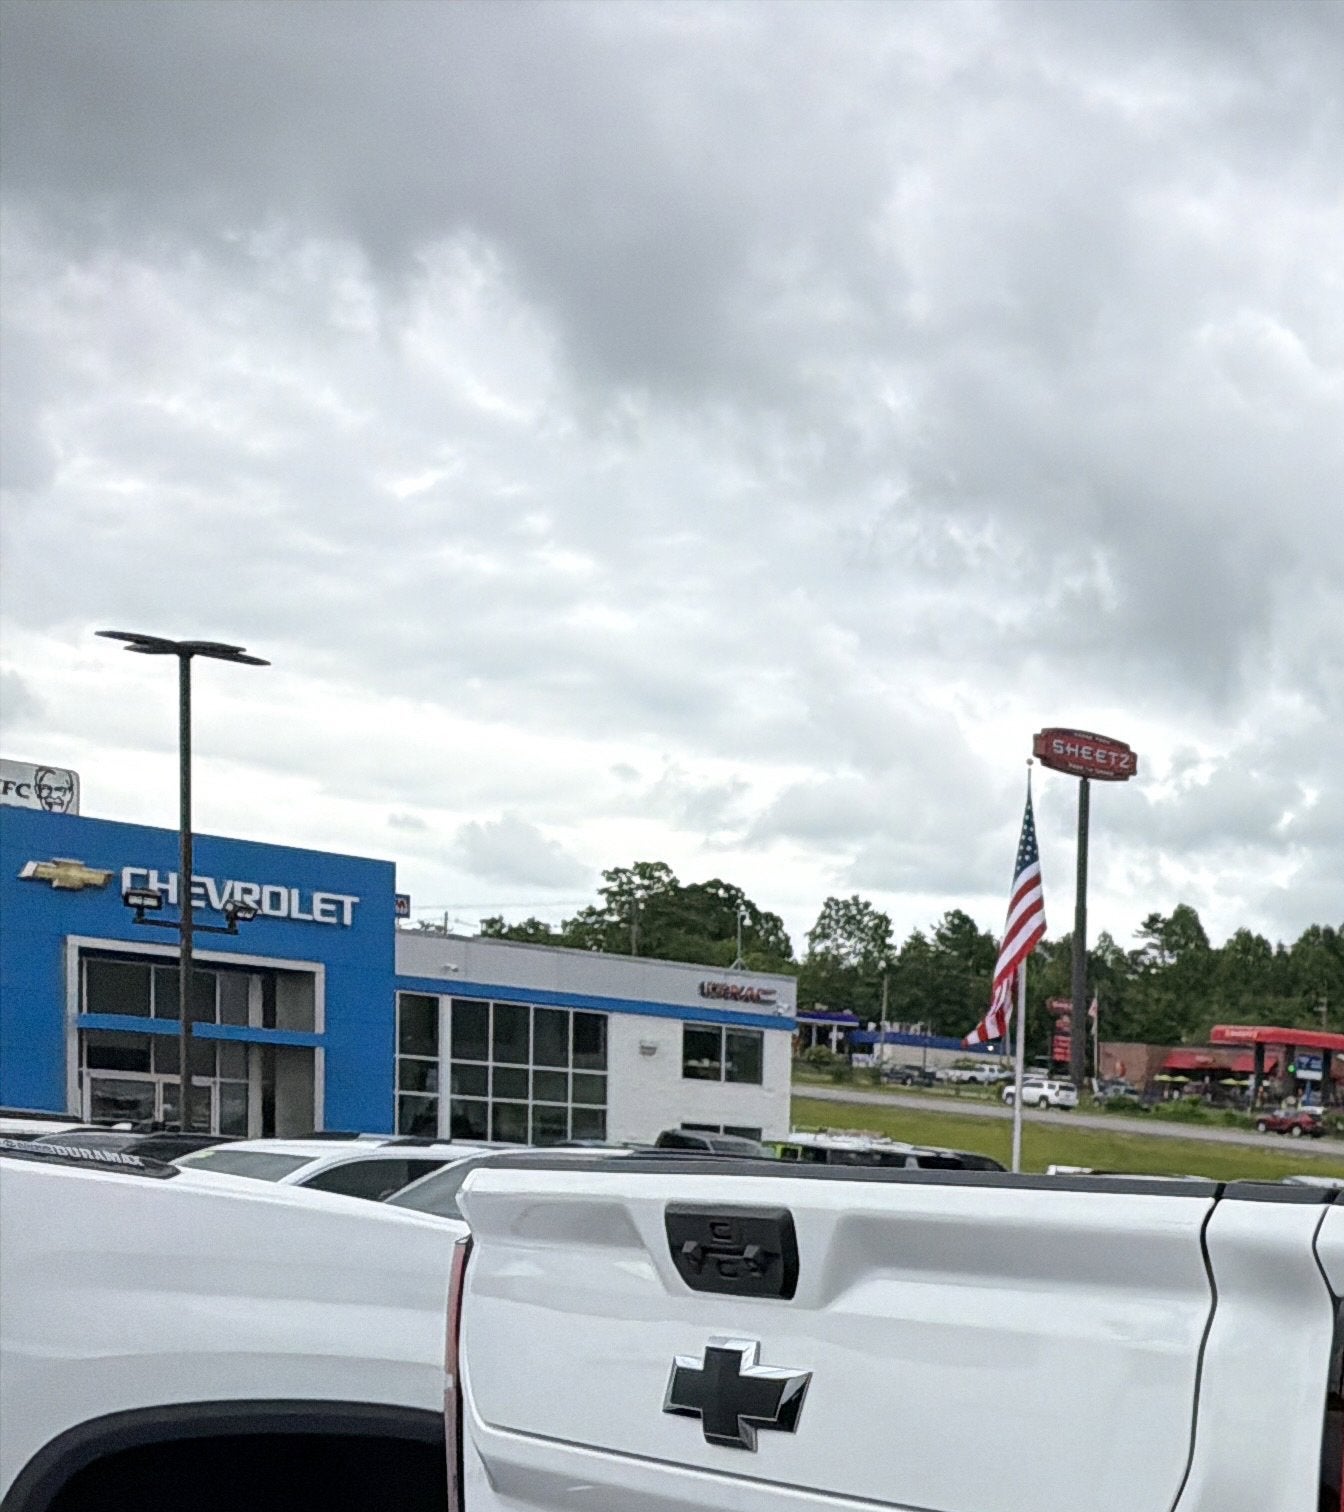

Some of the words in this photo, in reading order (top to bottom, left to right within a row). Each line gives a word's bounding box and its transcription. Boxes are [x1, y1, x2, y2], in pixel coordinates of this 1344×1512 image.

[1052, 739, 1130, 768] SHEETZ
[0, 779, 31, 799] FC
[121, 866, 360, 926] CHEVROLET
[54, 1144, 145, 1167] DURAMAX
